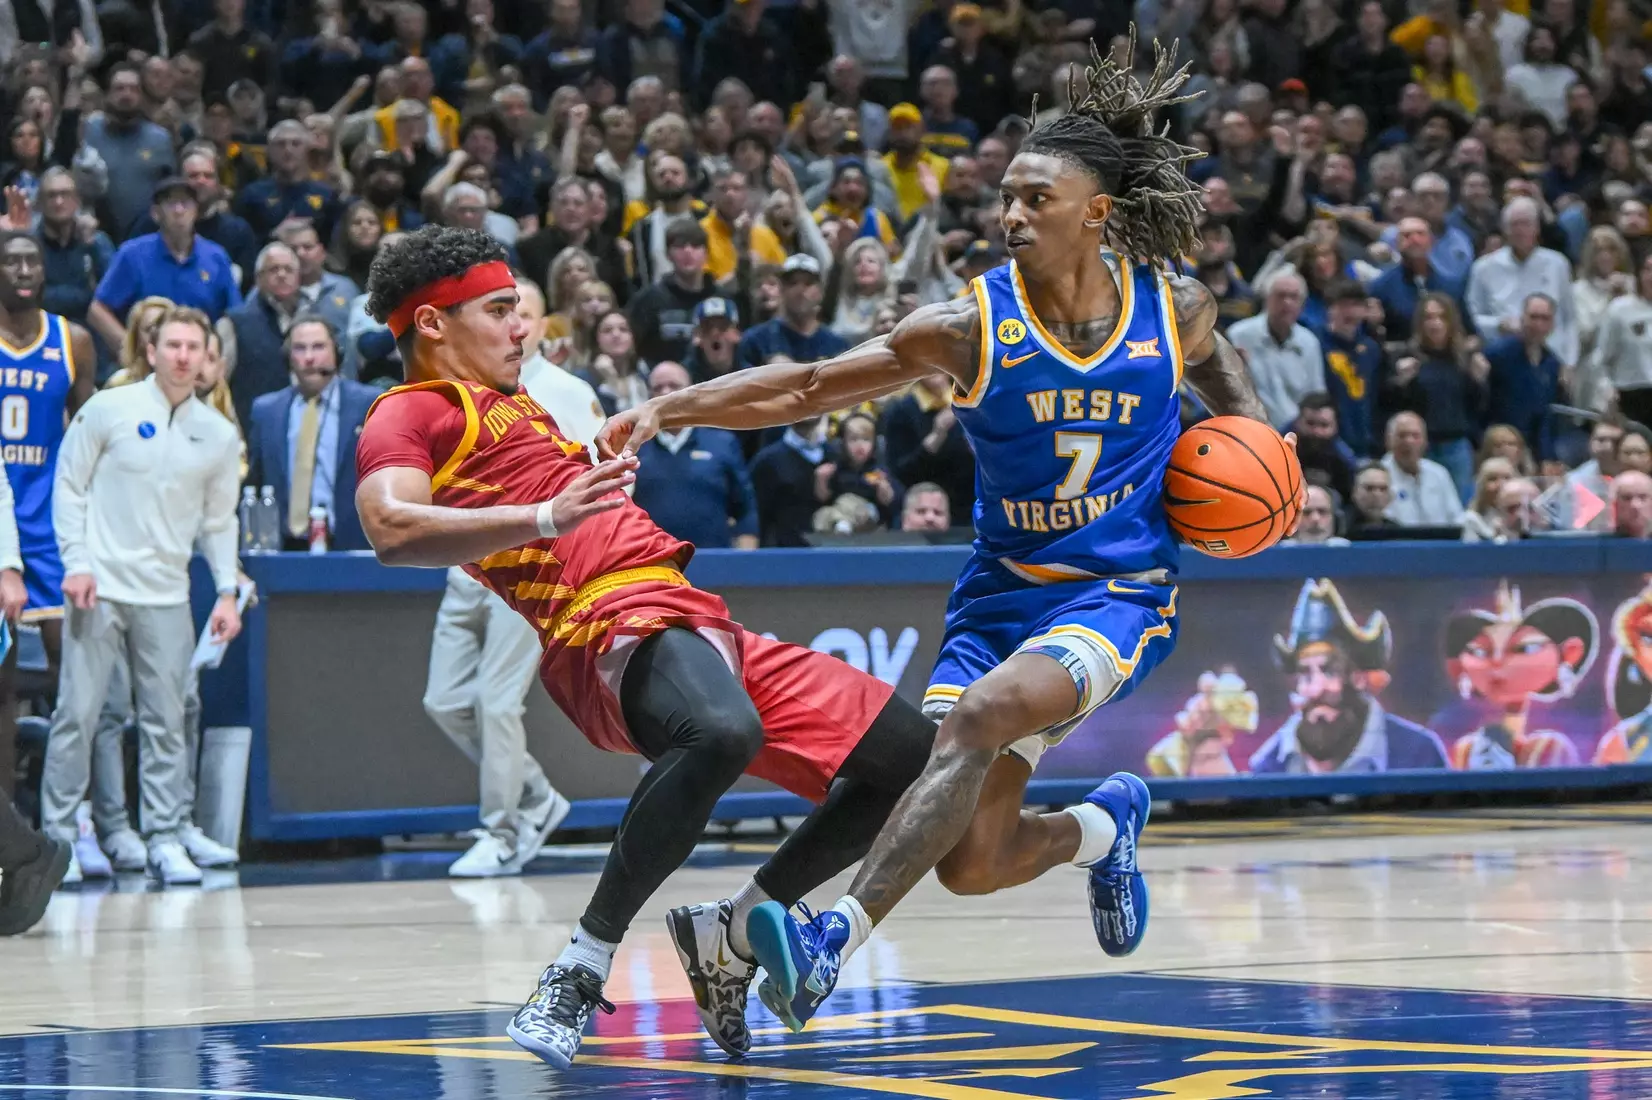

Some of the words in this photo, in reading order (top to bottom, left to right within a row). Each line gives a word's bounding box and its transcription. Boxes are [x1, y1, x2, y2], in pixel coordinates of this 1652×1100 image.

[1002, 327, 1020, 340] 44
[0, 367, 49, 392] EST
[2, 394, 29, 441] 0
[483, 400, 525, 444] IOWA
[1026, 389, 1141, 425] WEST
[1055, 431, 1103, 500] 7
